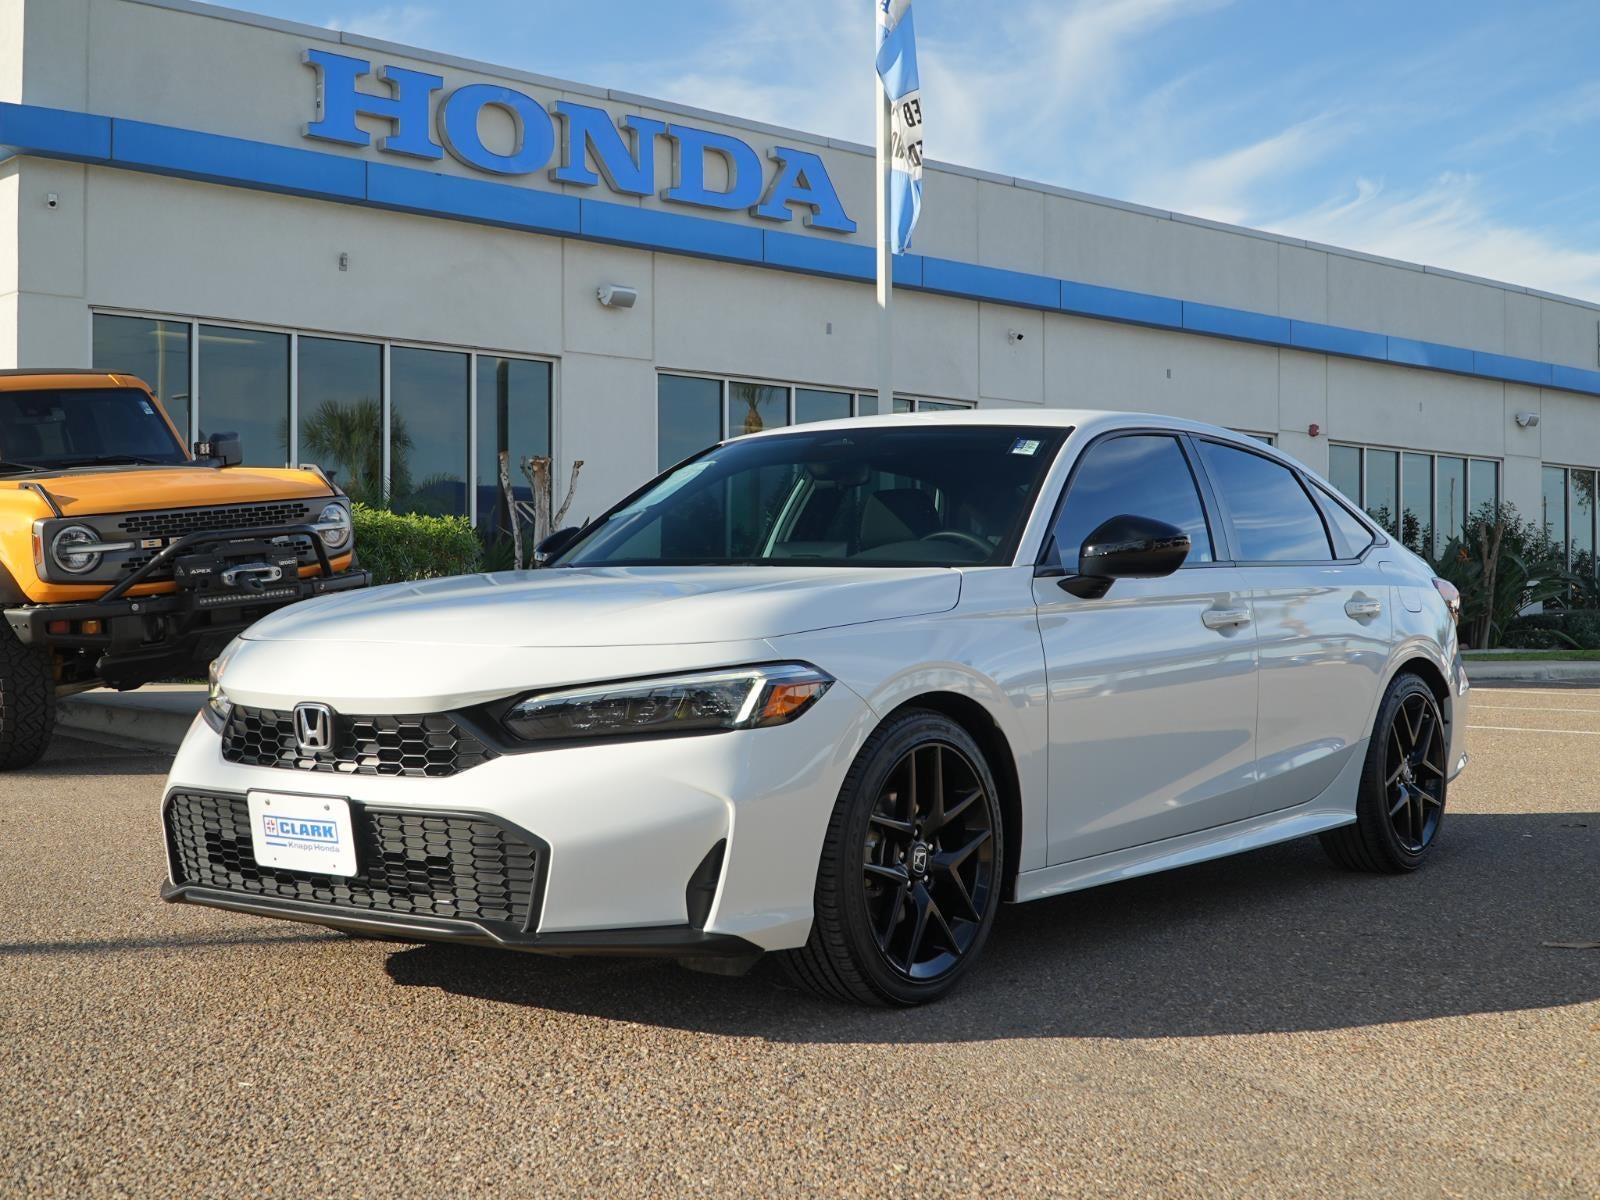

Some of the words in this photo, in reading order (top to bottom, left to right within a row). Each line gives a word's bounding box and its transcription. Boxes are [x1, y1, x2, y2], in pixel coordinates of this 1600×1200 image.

[303, 49, 857, 234] HONDA
[190, 567, 212, 575] APEX
[279, 821, 334, 839] CLARK
[288, 841, 313, 851] Knapp
[313, 843, 340, 853] Honda
